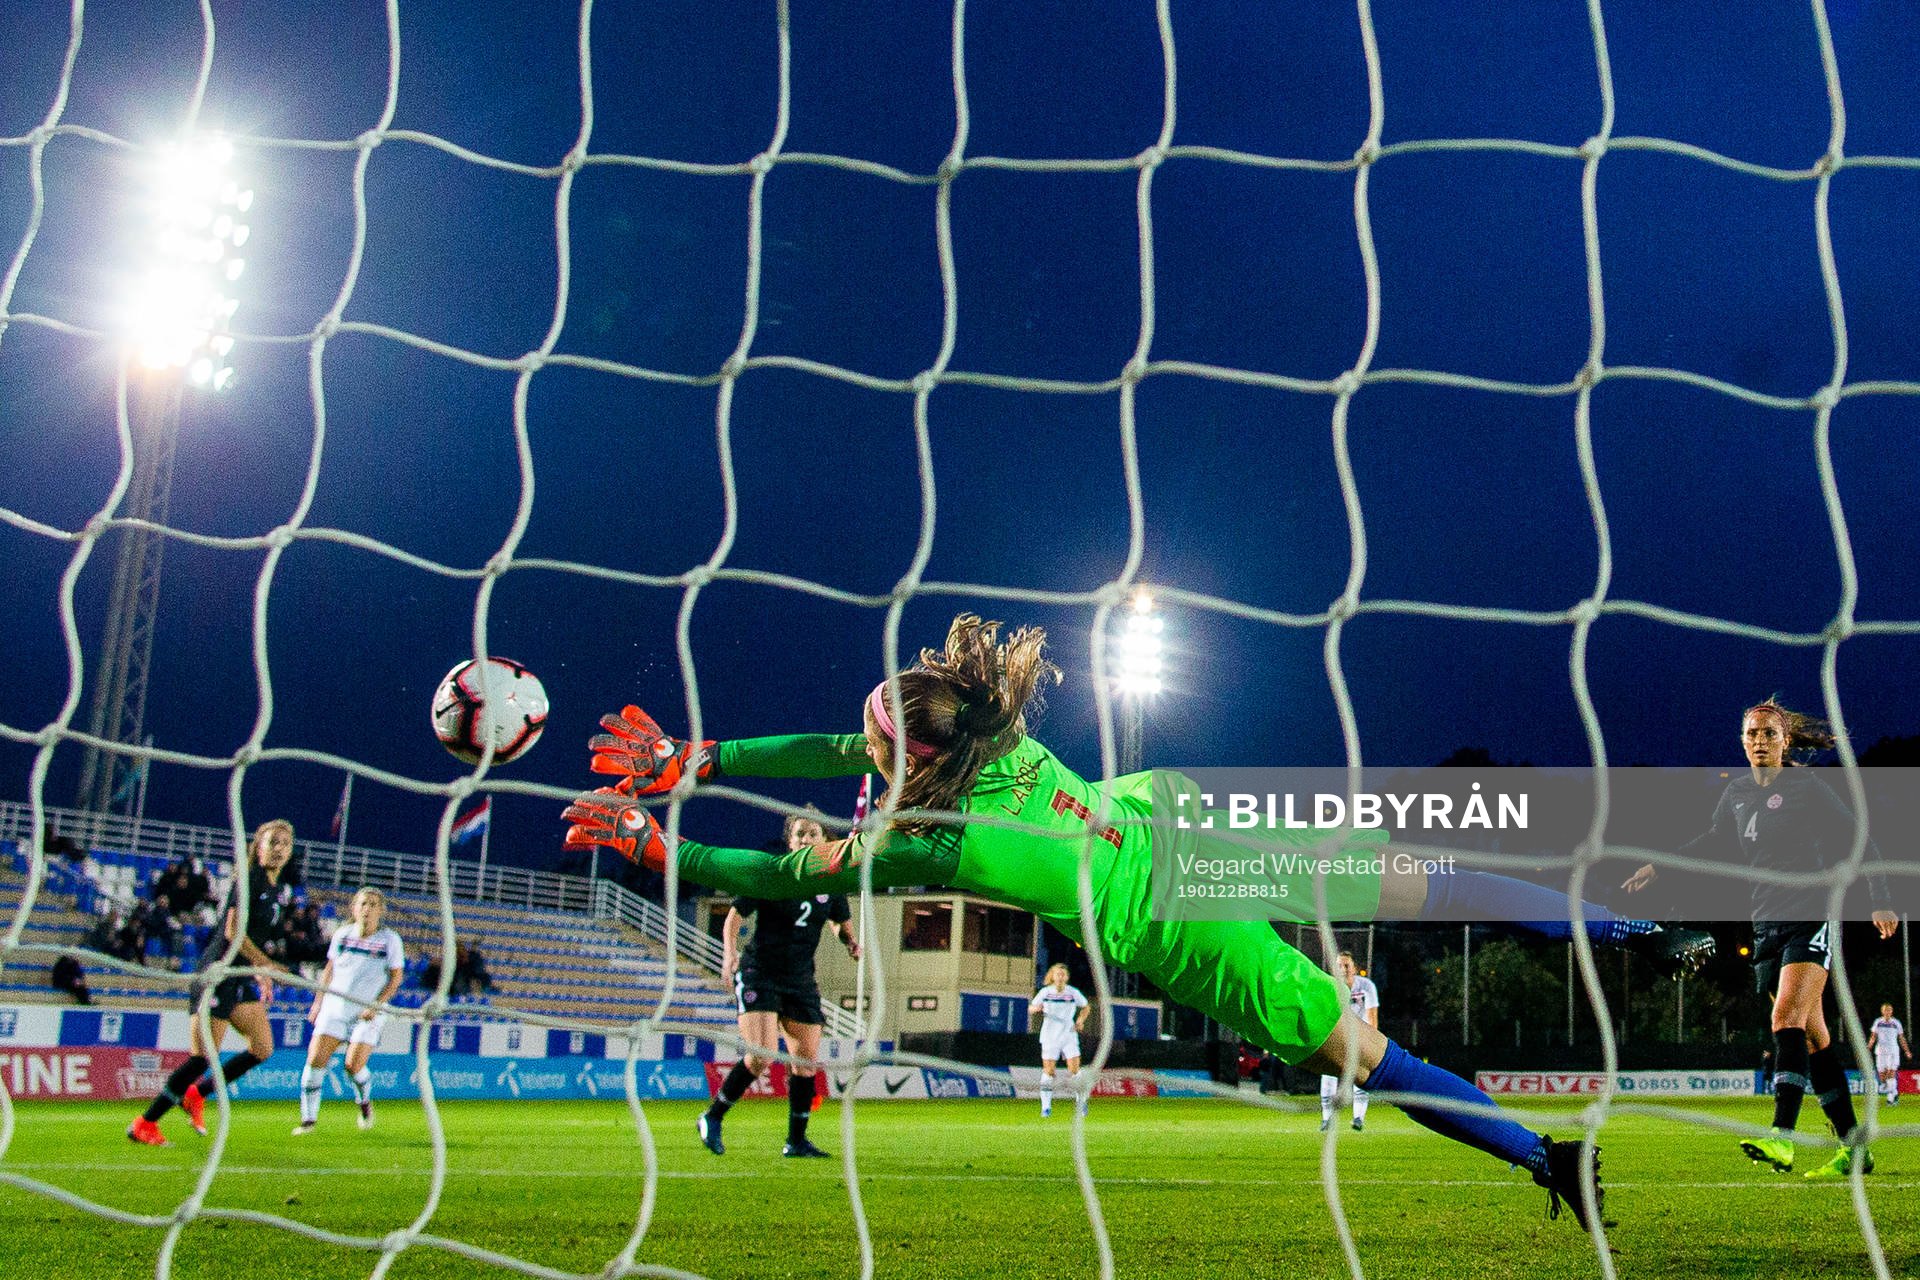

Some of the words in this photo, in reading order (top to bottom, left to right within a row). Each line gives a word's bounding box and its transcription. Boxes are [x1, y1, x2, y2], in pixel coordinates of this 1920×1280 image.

[1051, 788, 1124, 850] 1
[1743, 811, 1758, 842] 4
[795, 900, 812, 927] 2
[1808, 922, 1828, 951] 4
